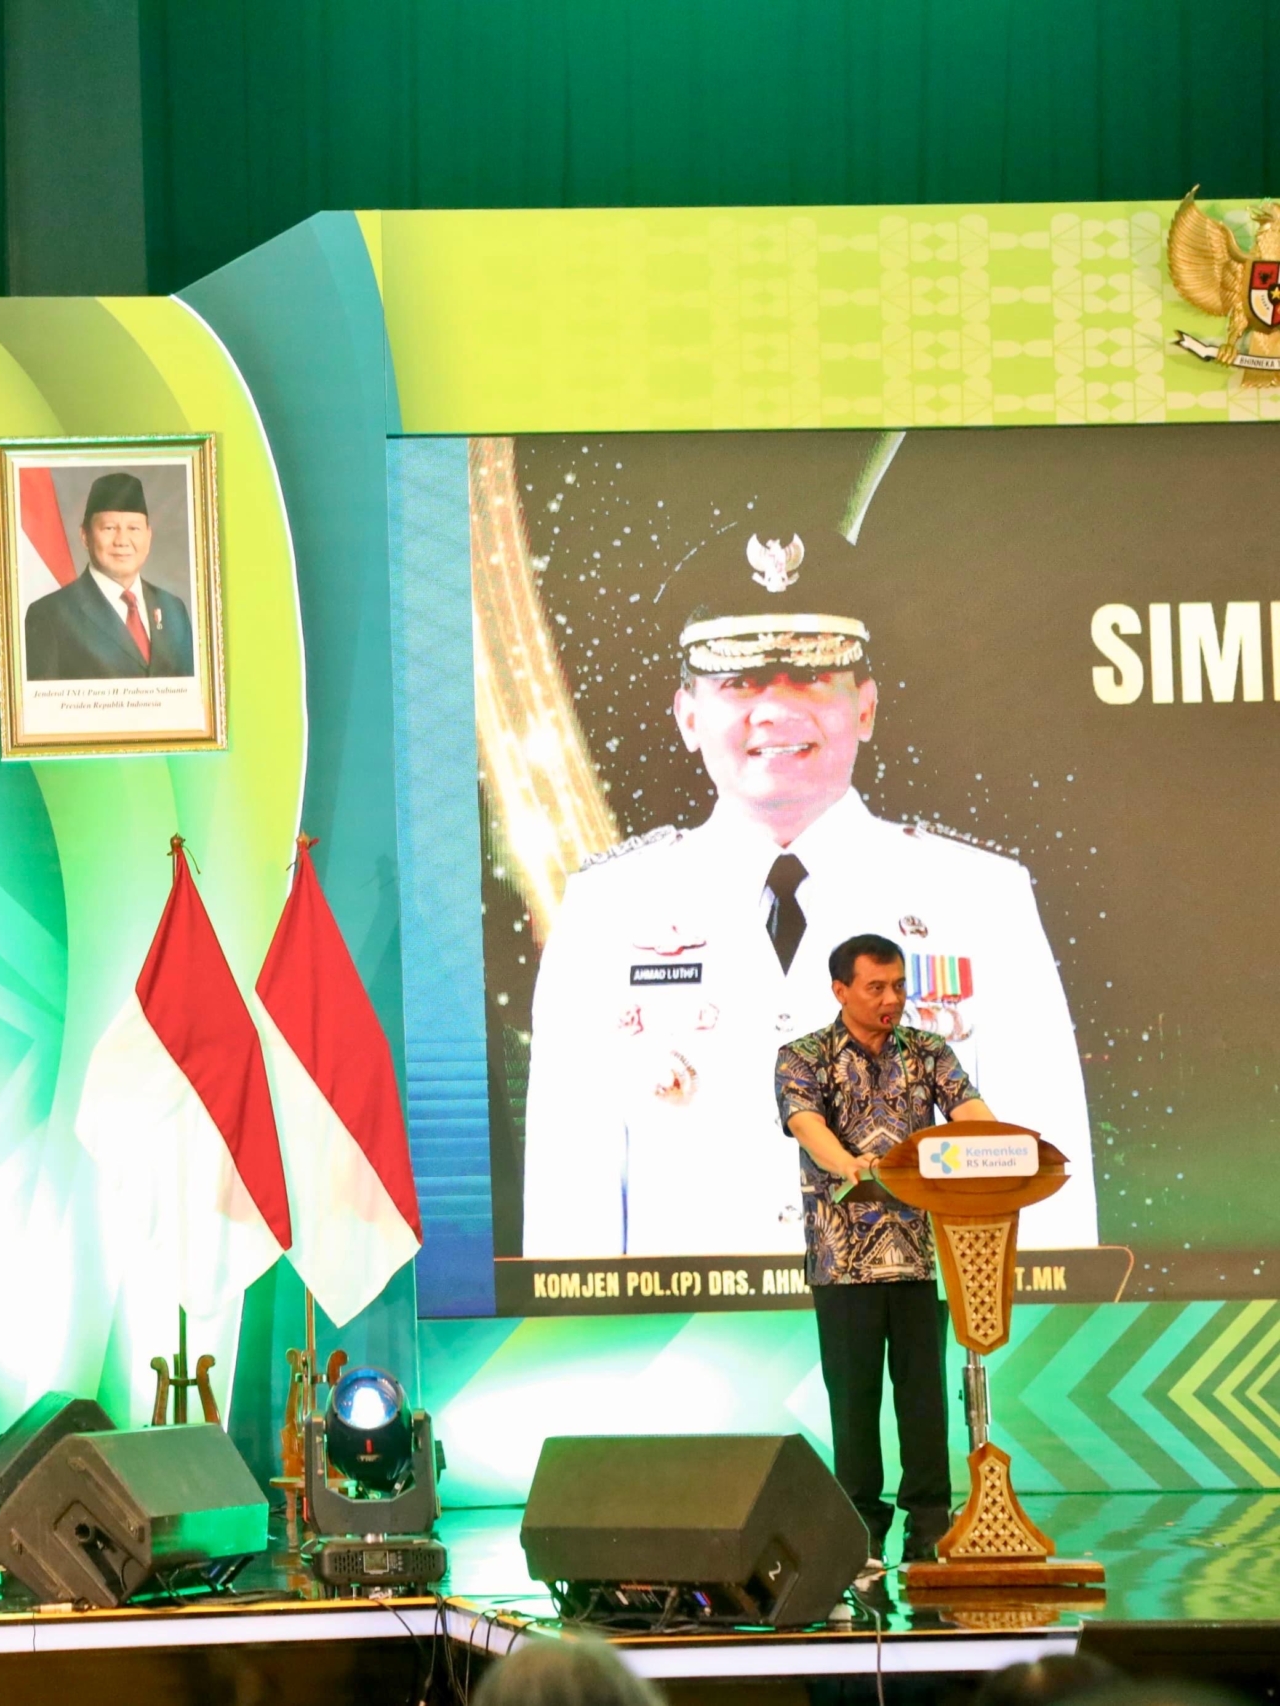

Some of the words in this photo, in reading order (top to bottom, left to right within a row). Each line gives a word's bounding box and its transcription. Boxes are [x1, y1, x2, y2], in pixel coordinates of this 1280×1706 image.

[126, 700, 162, 709] Indonesia
[965, 1145, 1029, 1158] Kemenkes
[966, 1159, 979, 1168] RS
[982, 1158, 1017, 1168] Kariadi
[533, 1271, 620, 1299] KOMJEN
[708, 1269, 757, 1296] DRS.
[762, 1267, 812, 1296] AHM
[1014, 1266, 1067, 1292] T.MK
